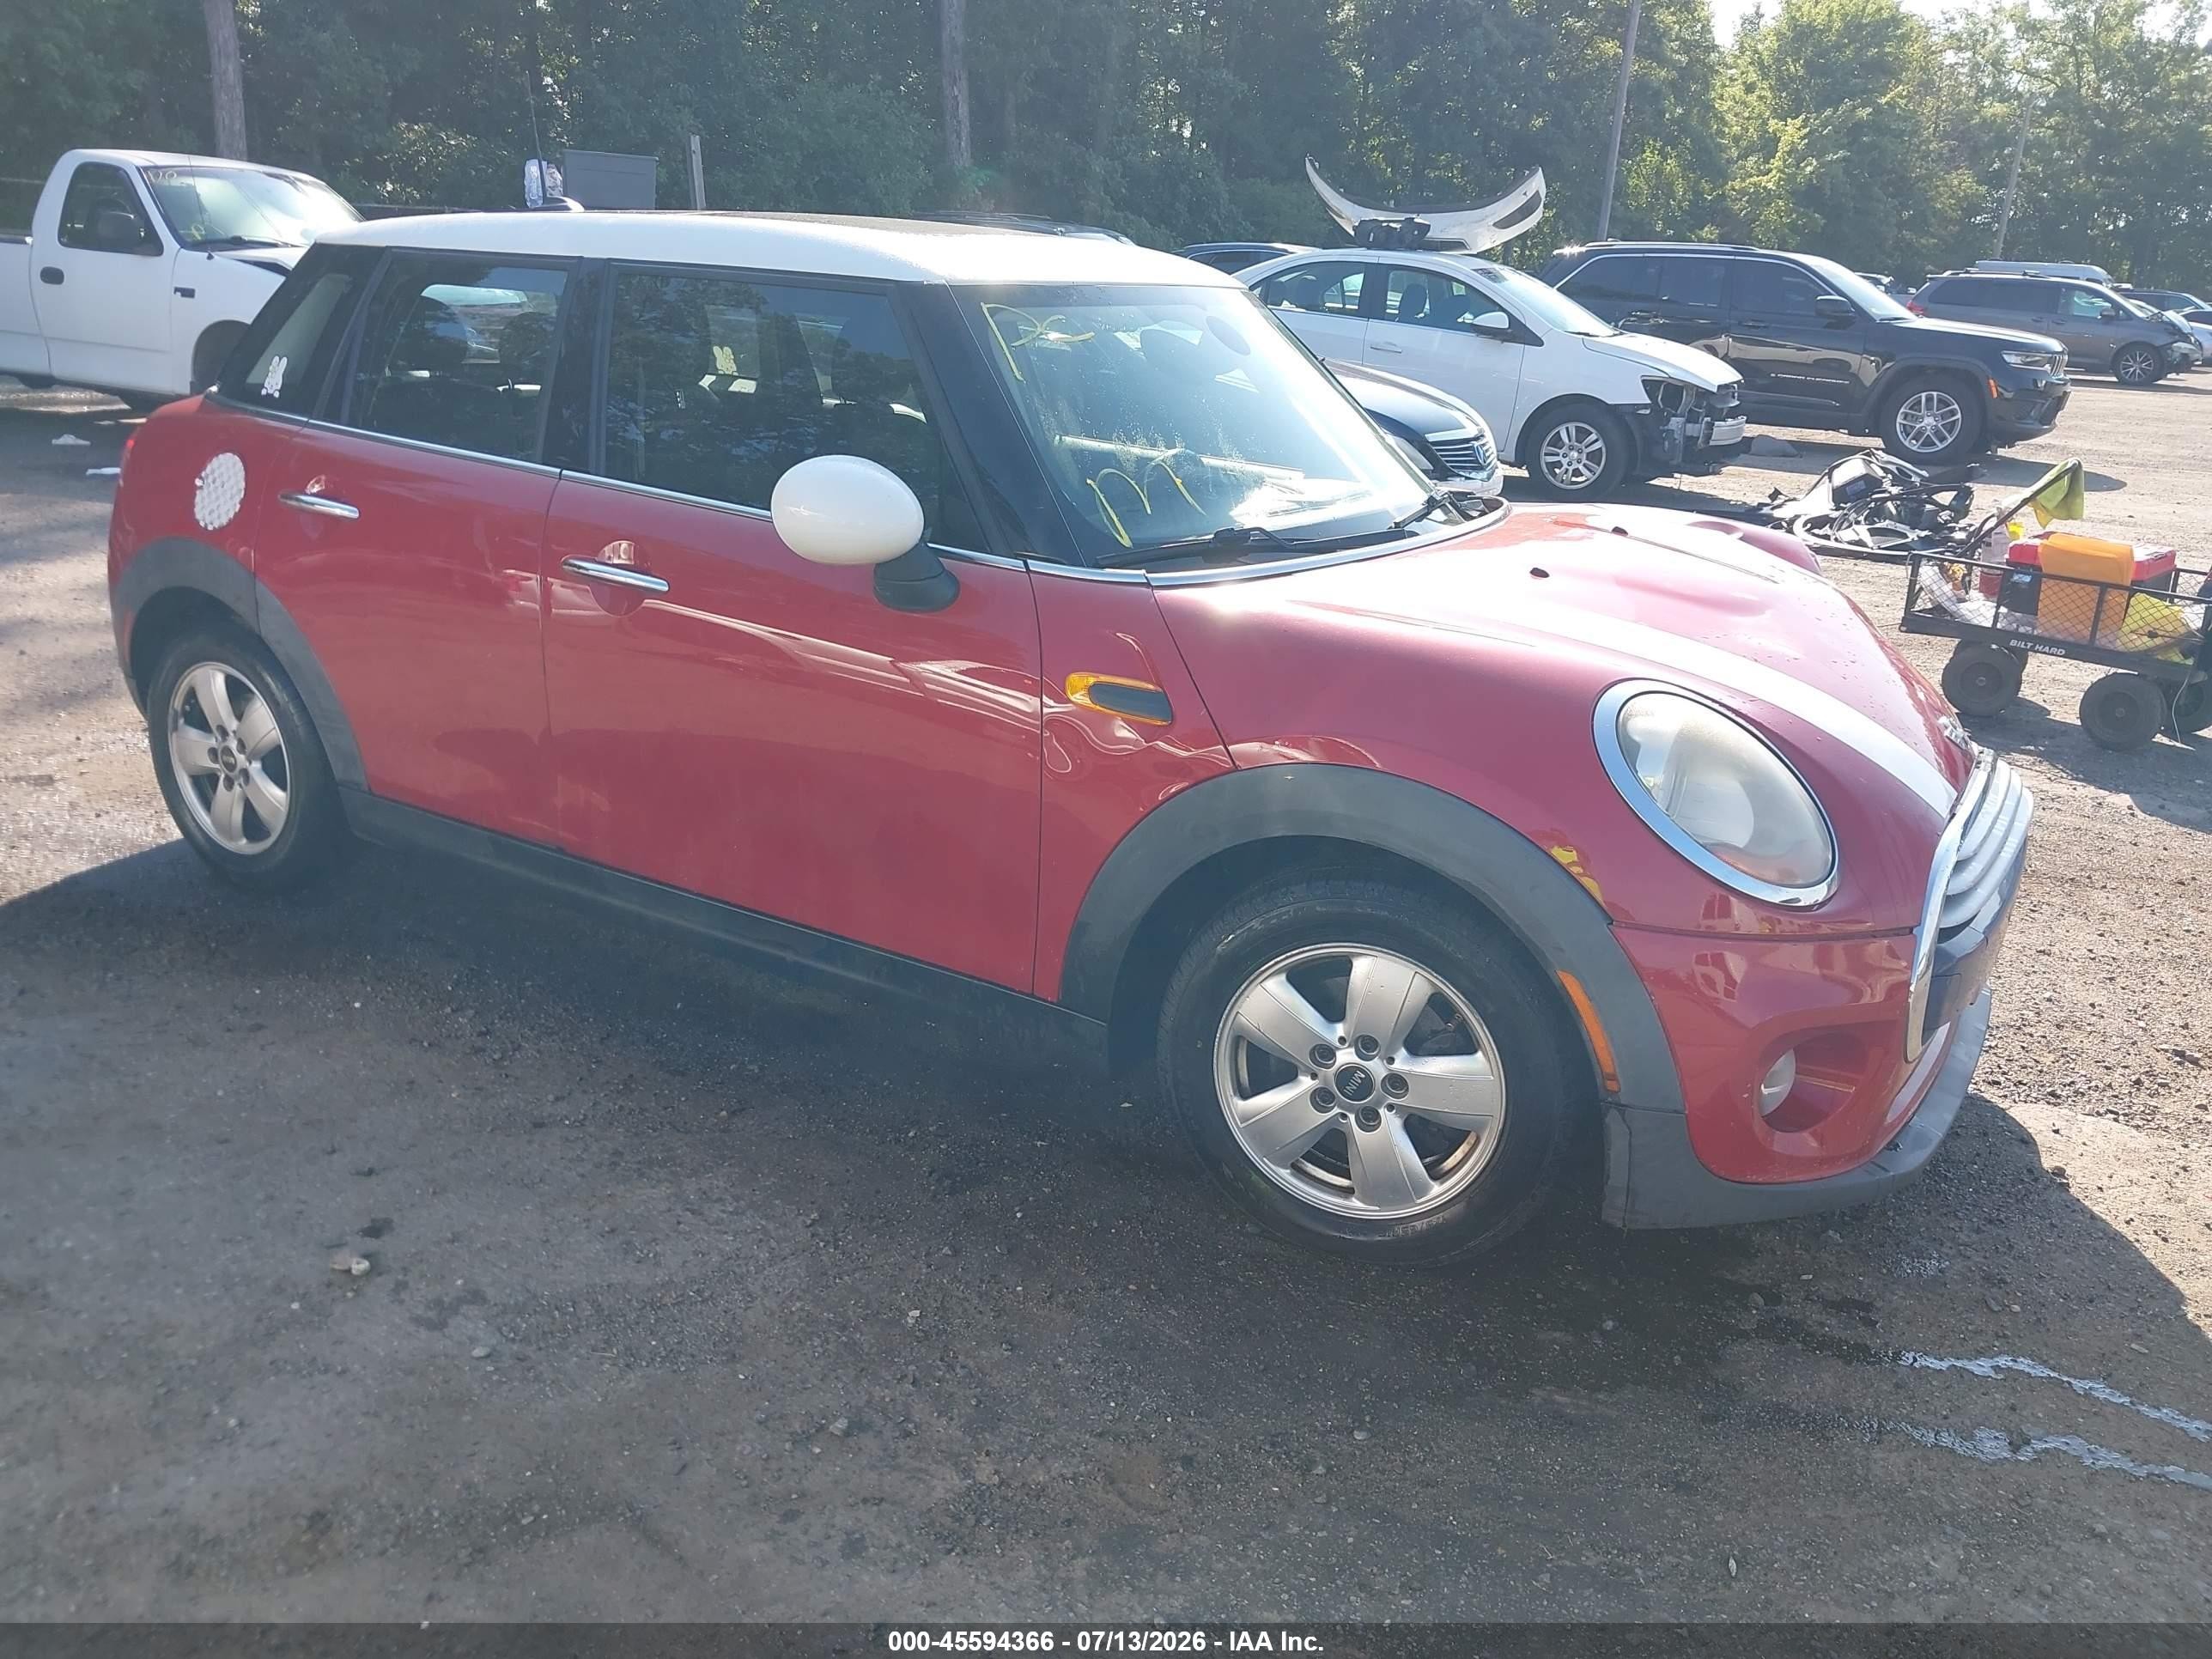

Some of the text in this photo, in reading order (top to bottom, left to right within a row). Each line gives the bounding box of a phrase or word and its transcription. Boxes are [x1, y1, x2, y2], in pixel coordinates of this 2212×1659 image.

[2009, 639, 2065, 655] BILT HARD
[1343, 1070, 1365, 1096] MINI
